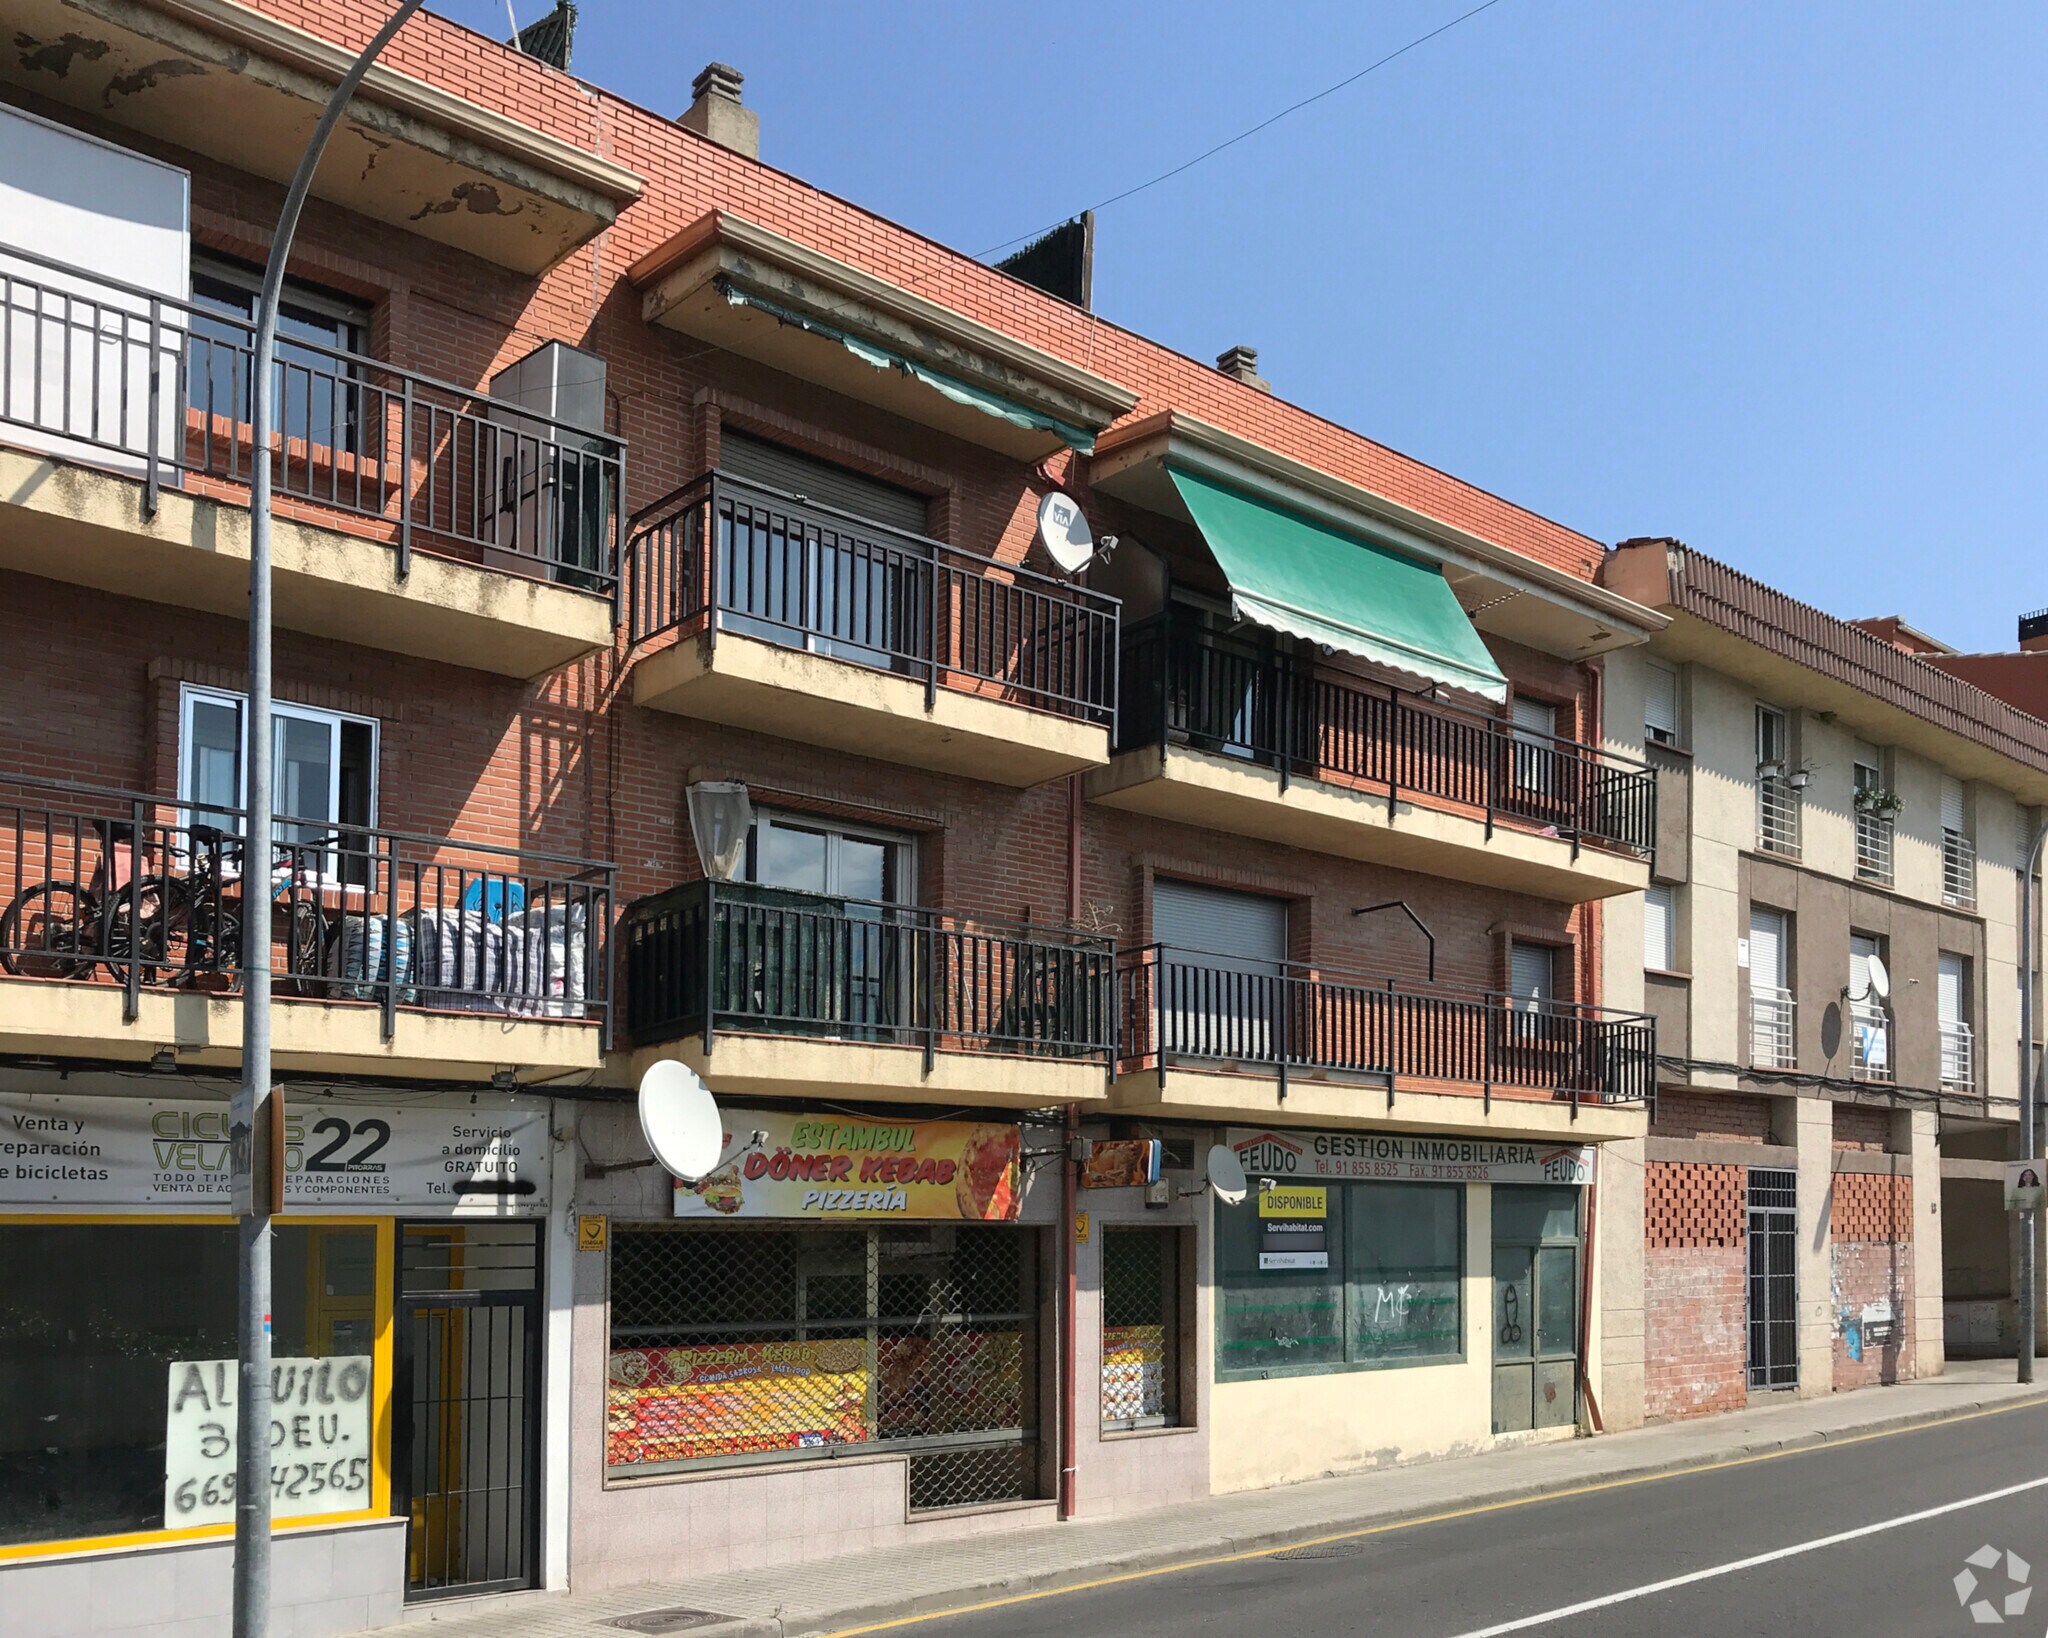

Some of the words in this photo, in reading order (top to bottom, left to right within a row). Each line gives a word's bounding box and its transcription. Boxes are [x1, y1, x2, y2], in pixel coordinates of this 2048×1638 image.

[12, 1115, 68, 1131] Venta
[74, 1121, 84, 1135] y
[152, 1111, 305, 1142] CICLS
[452, 1126, 512, 1139] Servicio
[305, 1117, 391, 1172] 22
[790, 1122, 916, 1152] ESTAMBUL
[442, 1145, 451, 1156] a
[455, 1144, 521, 1157] domicilio
[1240, 1143, 1296, 1172] FEUDO
[1314, 1135, 1403, 1159] GESTION
[1411, 1141, 1536, 1165] INMOBILIARIA
[16, 1165, 108, 1180] bicicletas
[444, 1161, 518, 1174] GRATUITO
[743, 1146, 854, 1183] DÖNER
[859, 1154, 957, 1185] KEBAB
[1315, 1159, 1332, 1174] Tel.
[1336, 1160, 1347, 1174] 91
[1352, 1161, 1371, 1175] 855
[1374, 1162, 1398, 1176] 8525
[1410, 1164, 1428, 1178] Fax.
[1432, 1165, 1443, 1178] 91
[1447, 1166, 1464, 1179] 855
[1466, 1167, 1489, 1179] 8526
[1544, 1157, 1585, 1182] FEUDO
[153, 1173, 195, 1182] TODO
[203, 1174, 229, 1183] TIP
[285, 1175, 390, 1185] EPARACIONES
[153, 1184, 194, 1193] VENTA
[198, 1185, 213, 1193] DE
[295, 1185, 302, 1194] Y
[304, 1186, 390, 1194] COMPONENTES
[426, 1182, 451, 1195] Tel.
[800, 1184, 907, 1211] PIZZERÍA
[1267, 1196, 1323, 1209] DISPONIBLE
[1267, 1223, 1323, 1232] Servihabitat.com
[173, 1361, 368, 1413] ALUILO
[174, 1457, 368, 1513] 66942565
